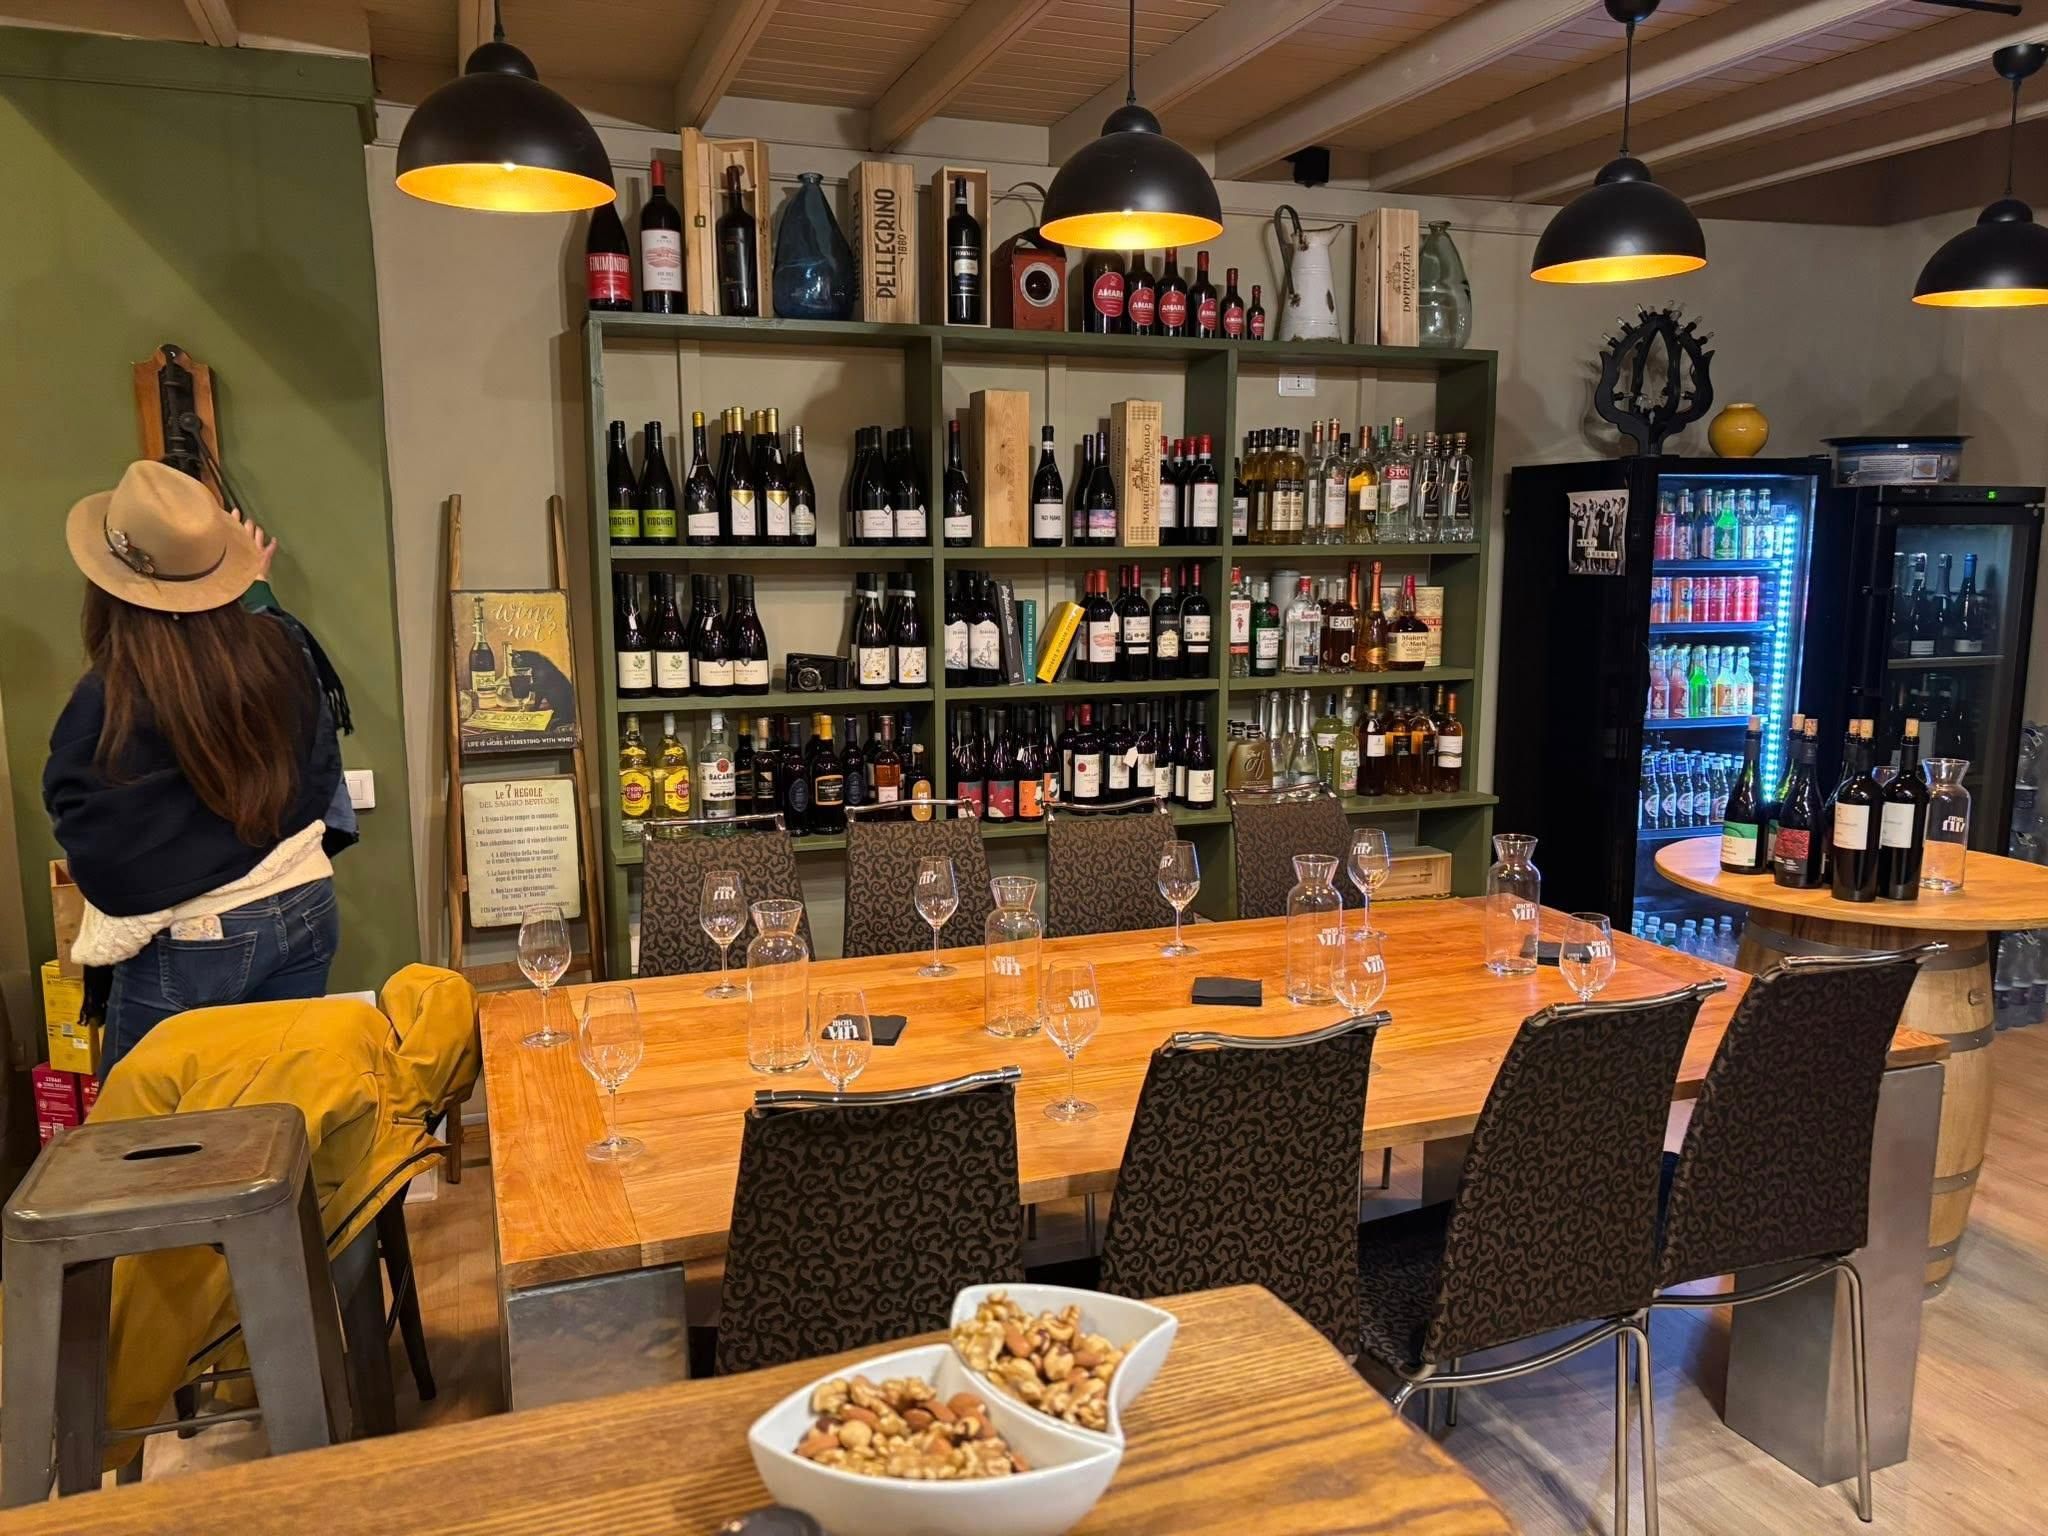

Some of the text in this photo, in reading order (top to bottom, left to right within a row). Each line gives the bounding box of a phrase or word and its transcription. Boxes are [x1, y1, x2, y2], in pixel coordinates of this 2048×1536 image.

[873, 188, 896, 299] PELLEGRINO
[896, 233, 908, 255] 1880
[1402, 244, 1412, 313] DOPPIOZETA
[1132, 301, 1153, 310] AMAR
[487, 738, 503, 746] MORE
[495, 784, 543, 799] Le 7 REGOLE
[525, 798, 559, 806] BEVITORE
[1511, 907, 1536, 920] vin
[1586, 945, 1611, 957] vin
[992, 960, 1021, 976] vin
[1068, 994, 1095, 1008] vin
[827, 1025, 859, 1040] vin
